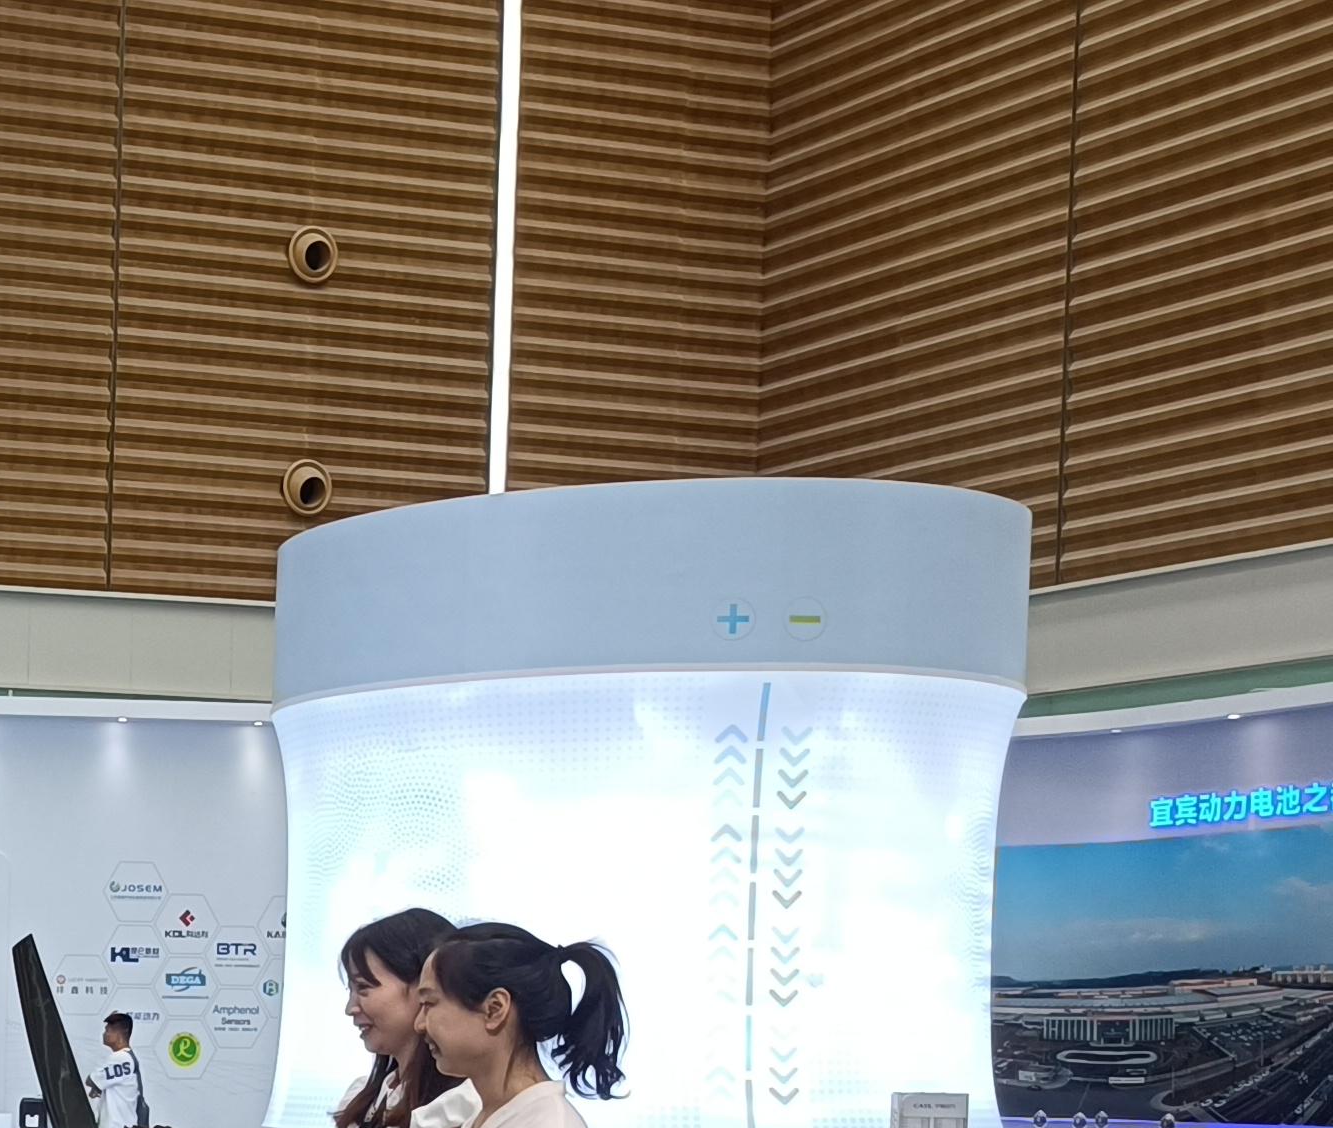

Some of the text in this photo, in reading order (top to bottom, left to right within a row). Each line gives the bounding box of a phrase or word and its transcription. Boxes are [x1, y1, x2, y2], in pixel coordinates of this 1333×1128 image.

[1149, 782, 1333, 827] 宜宾动力电池之
[121, 885, 163, 893] JOSEM
[216, 943, 257, 955] BTR
[170, 975, 202, 985] DEGA
[213, 1004, 260, 1015] Amphenol
[221, 1018, 251, 1026] Sensors
[104, 1061, 132, 1081] LOS
